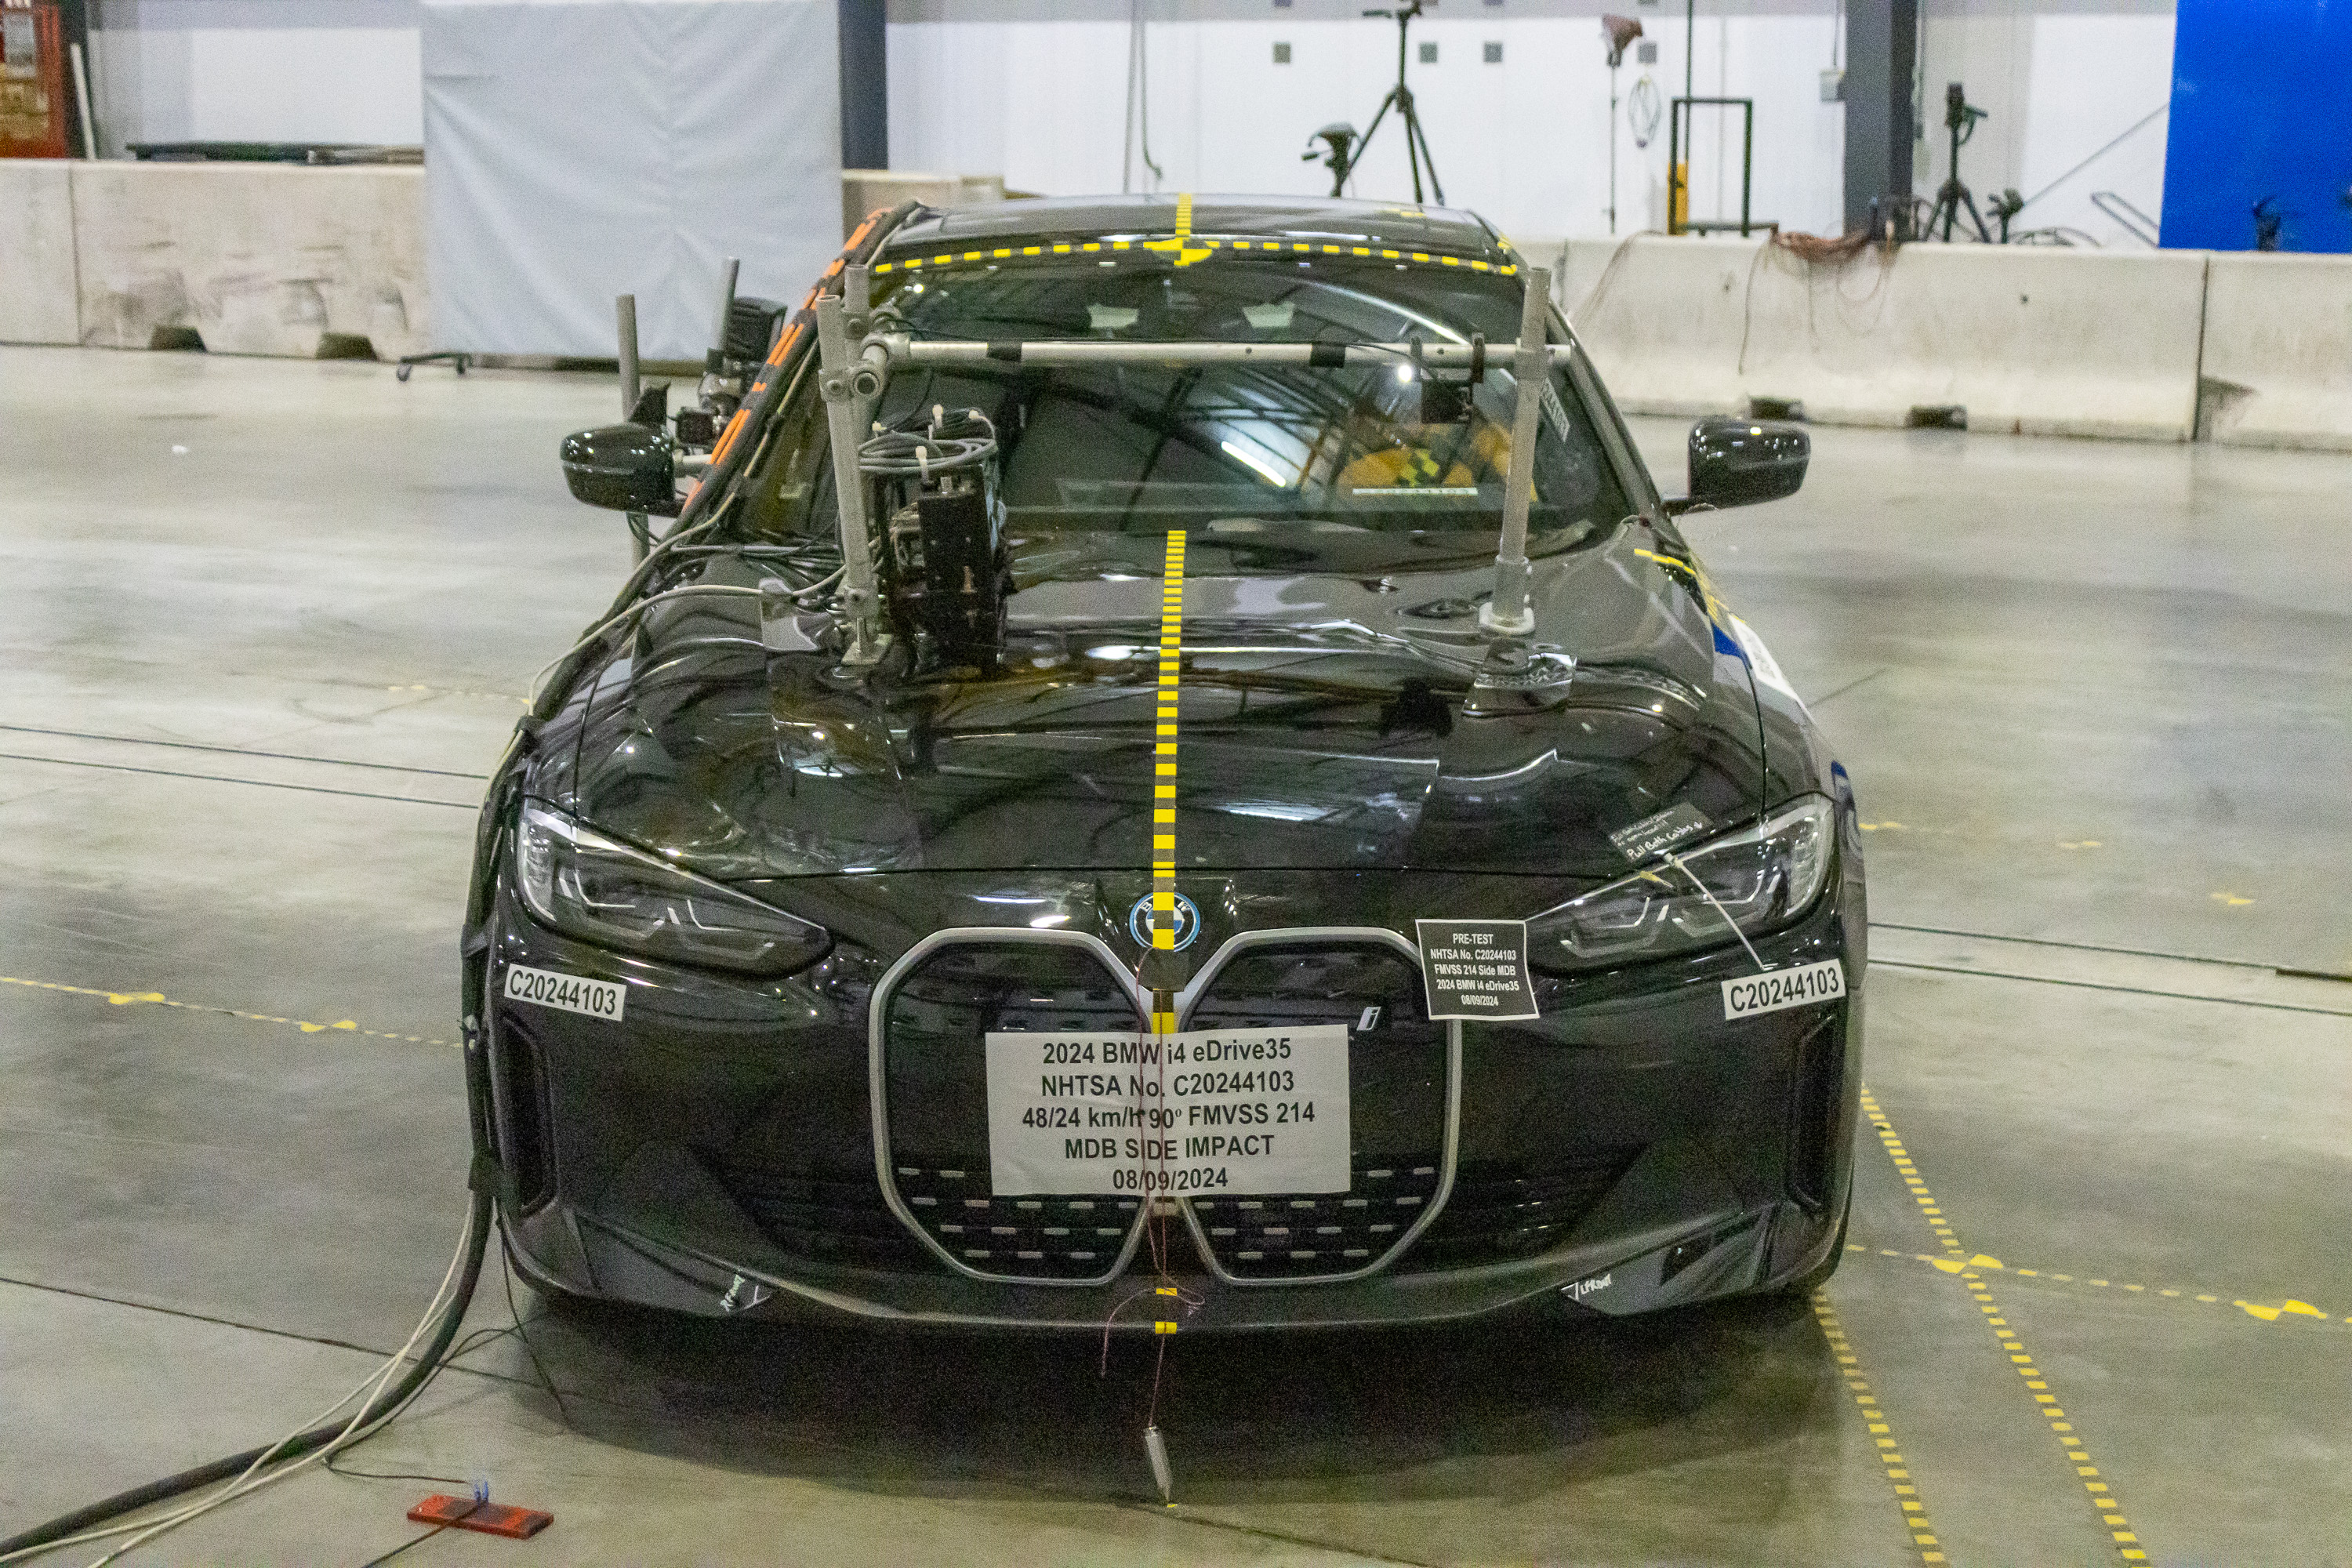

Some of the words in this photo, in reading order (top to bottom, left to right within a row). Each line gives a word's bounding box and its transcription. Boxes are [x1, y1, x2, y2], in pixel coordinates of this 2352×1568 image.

[1627, 844, 1646, 860] Pull
[1645, 836, 1668, 851] Both
[1141, 901, 1192, 913] BW
[1452, 933, 1494, 945] PRE-TEST
[1430, 948, 1459, 960] NHTSA
[1460, 949, 1473, 960] No.
[1475, 949, 1516, 960] C20244103
[1434, 964, 1462, 975] FMVSS
[1464, 964, 1477, 975] 214
[1478, 964, 1495, 976] Side
[1497, 965, 1516, 976] MDB
[510, 969, 616, 1015] C20244103
[1436, 979, 1455, 990] 2024
[1457, 979, 1475, 990] BMW
[1485, 980, 1520, 991] eDrive35
[1730, 967, 1839, 1012] C20244103
[1461, 994, 1499, 1007] 08/09/2024
[1043, 1042, 1095, 1064] 2024
[1102, 1042, 1160, 1065] BMW
[1167, 1042, 1186, 1065] i4
[1192, 1037, 1291, 1062] eDrive35
[1041, 1075, 1122, 1097] NHTSA
[1130, 1074, 1165, 1097] No.
[1173, 1070, 1294, 1097] C20244103
[1022, 1106, 1081, 1128] 48/24
[1088, 1106, 1144, 1127] km/h
[1189, 1102, 1269, 1126] FMVSS
[1276, 1101, 1316, 1123] 214
[1065, 1138, 1117, 1159] MDB
[1125, 1138, 1178, 1160] SIDE
[1185, 1134, 1275, 1158] IMPACT
[1112, 1167, 1229, 1192] 08/09/2024
